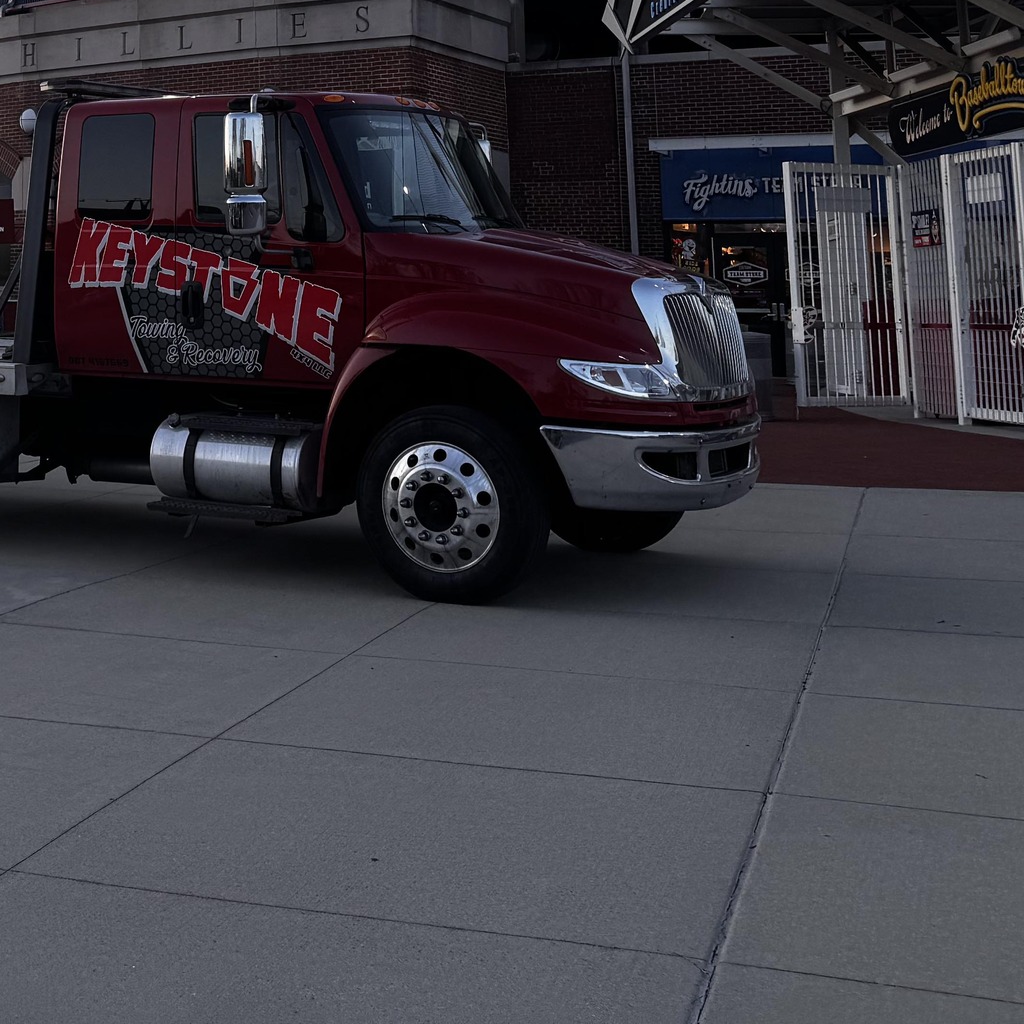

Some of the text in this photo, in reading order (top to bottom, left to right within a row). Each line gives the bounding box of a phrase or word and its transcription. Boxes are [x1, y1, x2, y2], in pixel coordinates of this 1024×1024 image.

[899, 108, 941, 144] Welcome
[943, 103, 953, 123] to
[683, 173, 757, 211] Fightins
[762, 176, 803, 193] TEM
[68, 216, 343, 373] KEYSTONE
[129, 315, 190, 346] Towing
[166, 342, 263, 373] & Recovery
[311, 360, 333, 379] LLC
